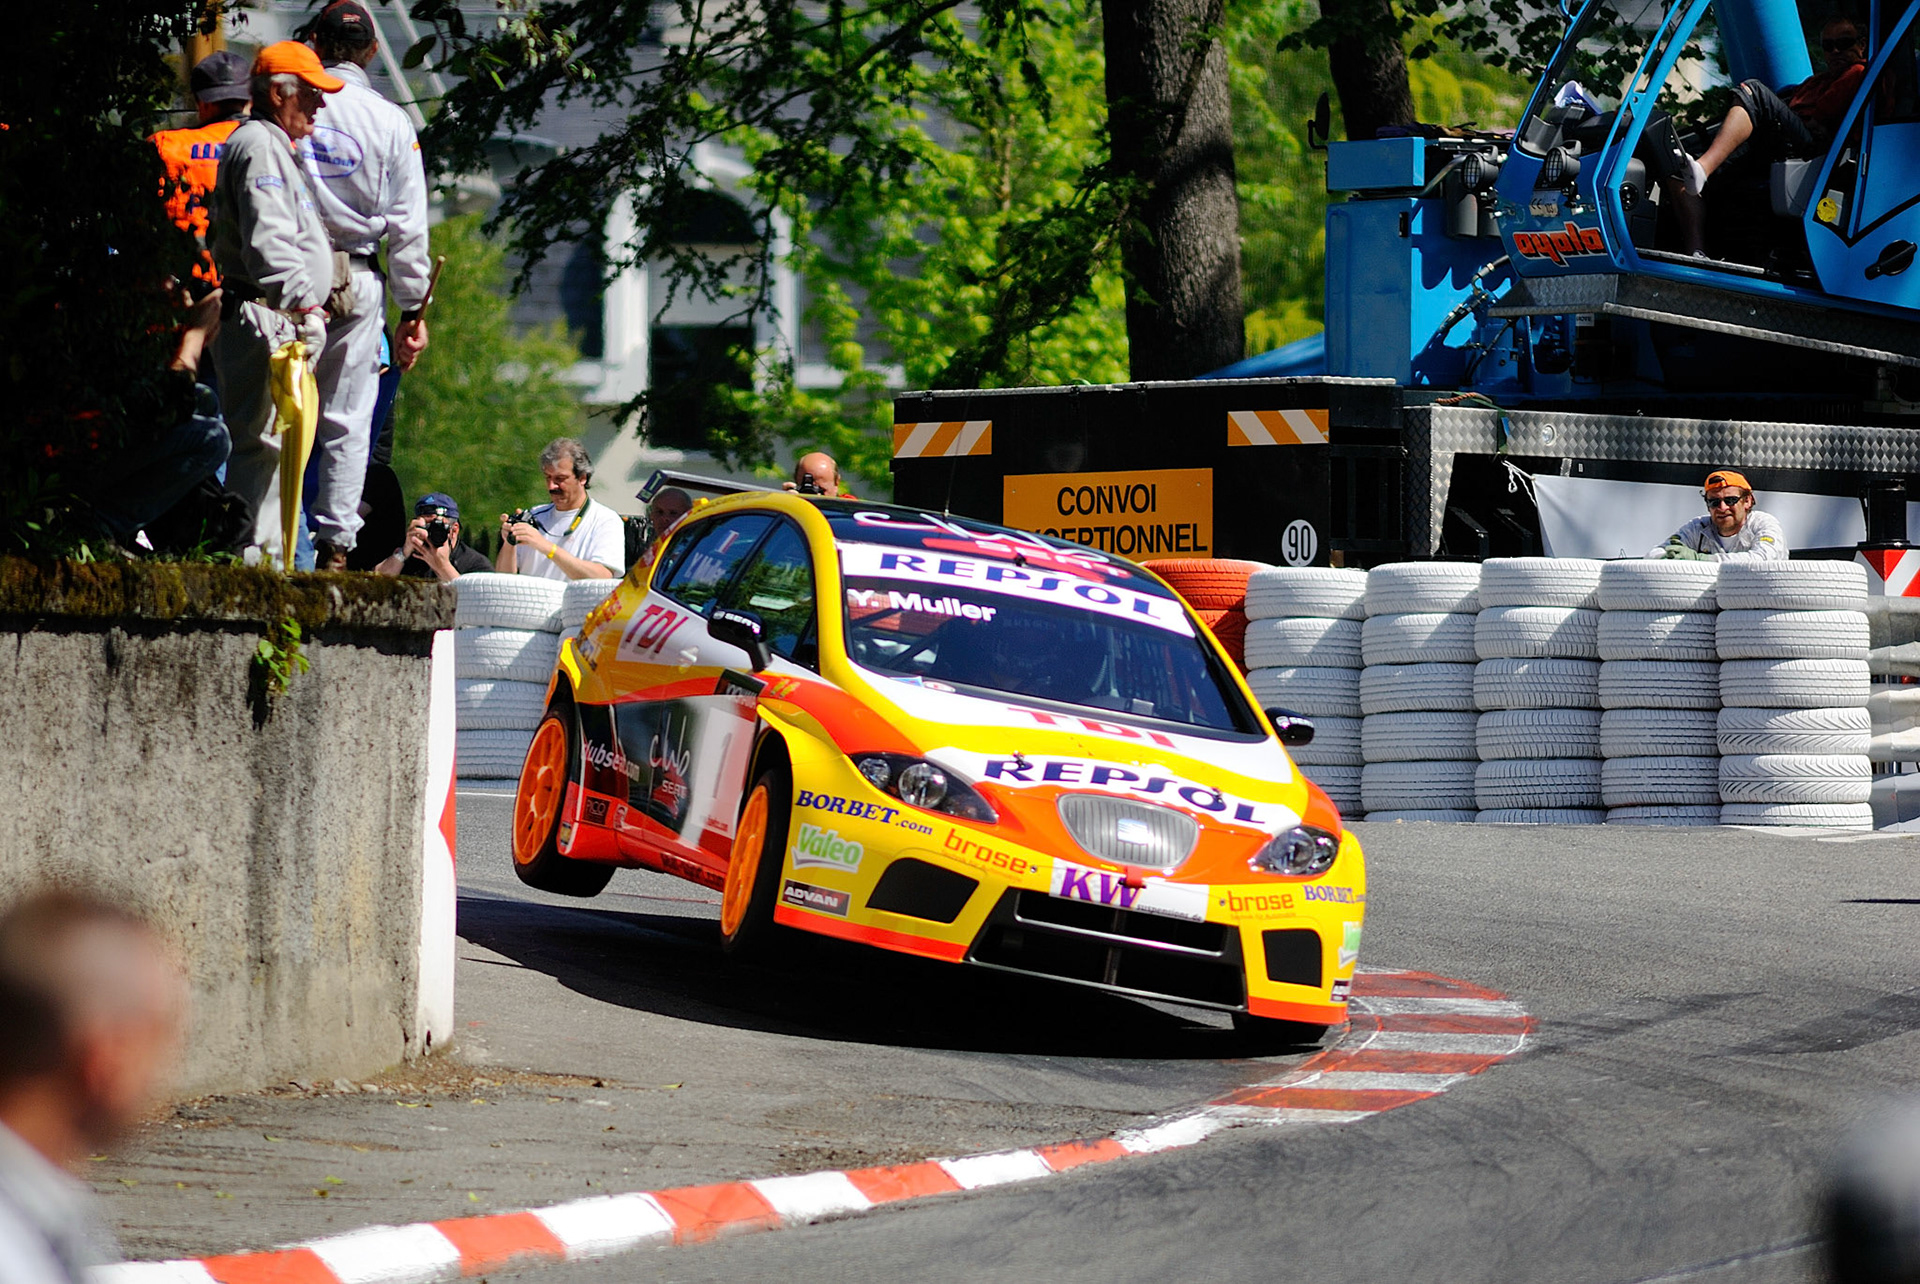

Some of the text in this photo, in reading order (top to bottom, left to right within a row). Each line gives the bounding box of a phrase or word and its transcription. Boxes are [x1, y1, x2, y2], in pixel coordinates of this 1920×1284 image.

[1057, 484, 1156, 516] CONVOI
[1287, 524, 1312, 561] 90
[846, 588, 997, 622] Y. Muller
[880, 551, 1161, 621] REPSOL
[624, 603, 689, 655] TDI
[1007, 707, 1178, 749] TDI
[984, 759, 1266, 825] REPSOL
[799, 825, 861, 866] Valeo
[944, 827, 1028, 875] brose
[784, 886, 839, 908] ADVAN
[1059, 866, 1143, 911] KW
[1228, 890, 1295, 912] brose
